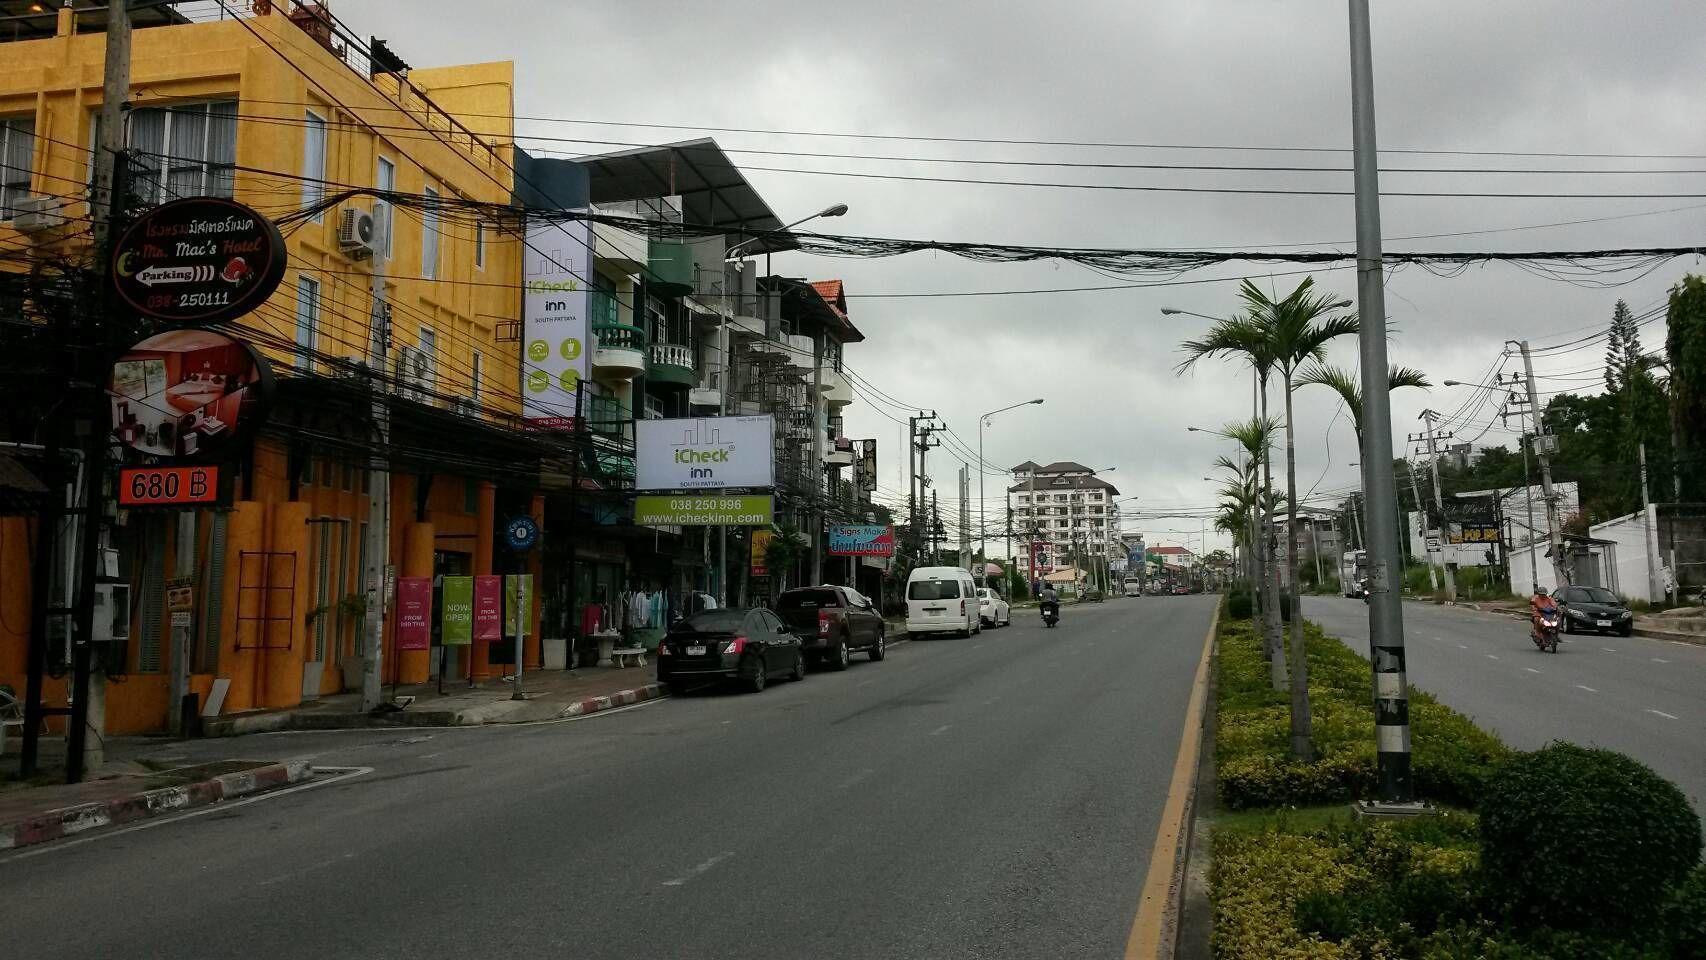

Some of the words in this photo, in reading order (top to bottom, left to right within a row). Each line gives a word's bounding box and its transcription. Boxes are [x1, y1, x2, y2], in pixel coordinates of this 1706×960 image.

[175, 240, 217, 257] Mac's
[223, 236, 263, 255] Hotel
[141, 270, 193, 282] Parking
[528, 279, 577, 295] iCheck
[545, 301, 567, 311] inn
[675, 449, 729, 464] iCheck
[690, 467, 713, 479] inn
[131, 472, 180, 499] 680
[671, 500, 692, 510] 038
[695, 500, 717, 510] 250
[719, 499, 742, 510] 996
[643, 513, 764, 524] www.icheckinn.com
[839, 527, 861, 537] Signs
[447, 604, 468, 612] NOW
[445, 613, 470, 622] OPEN
